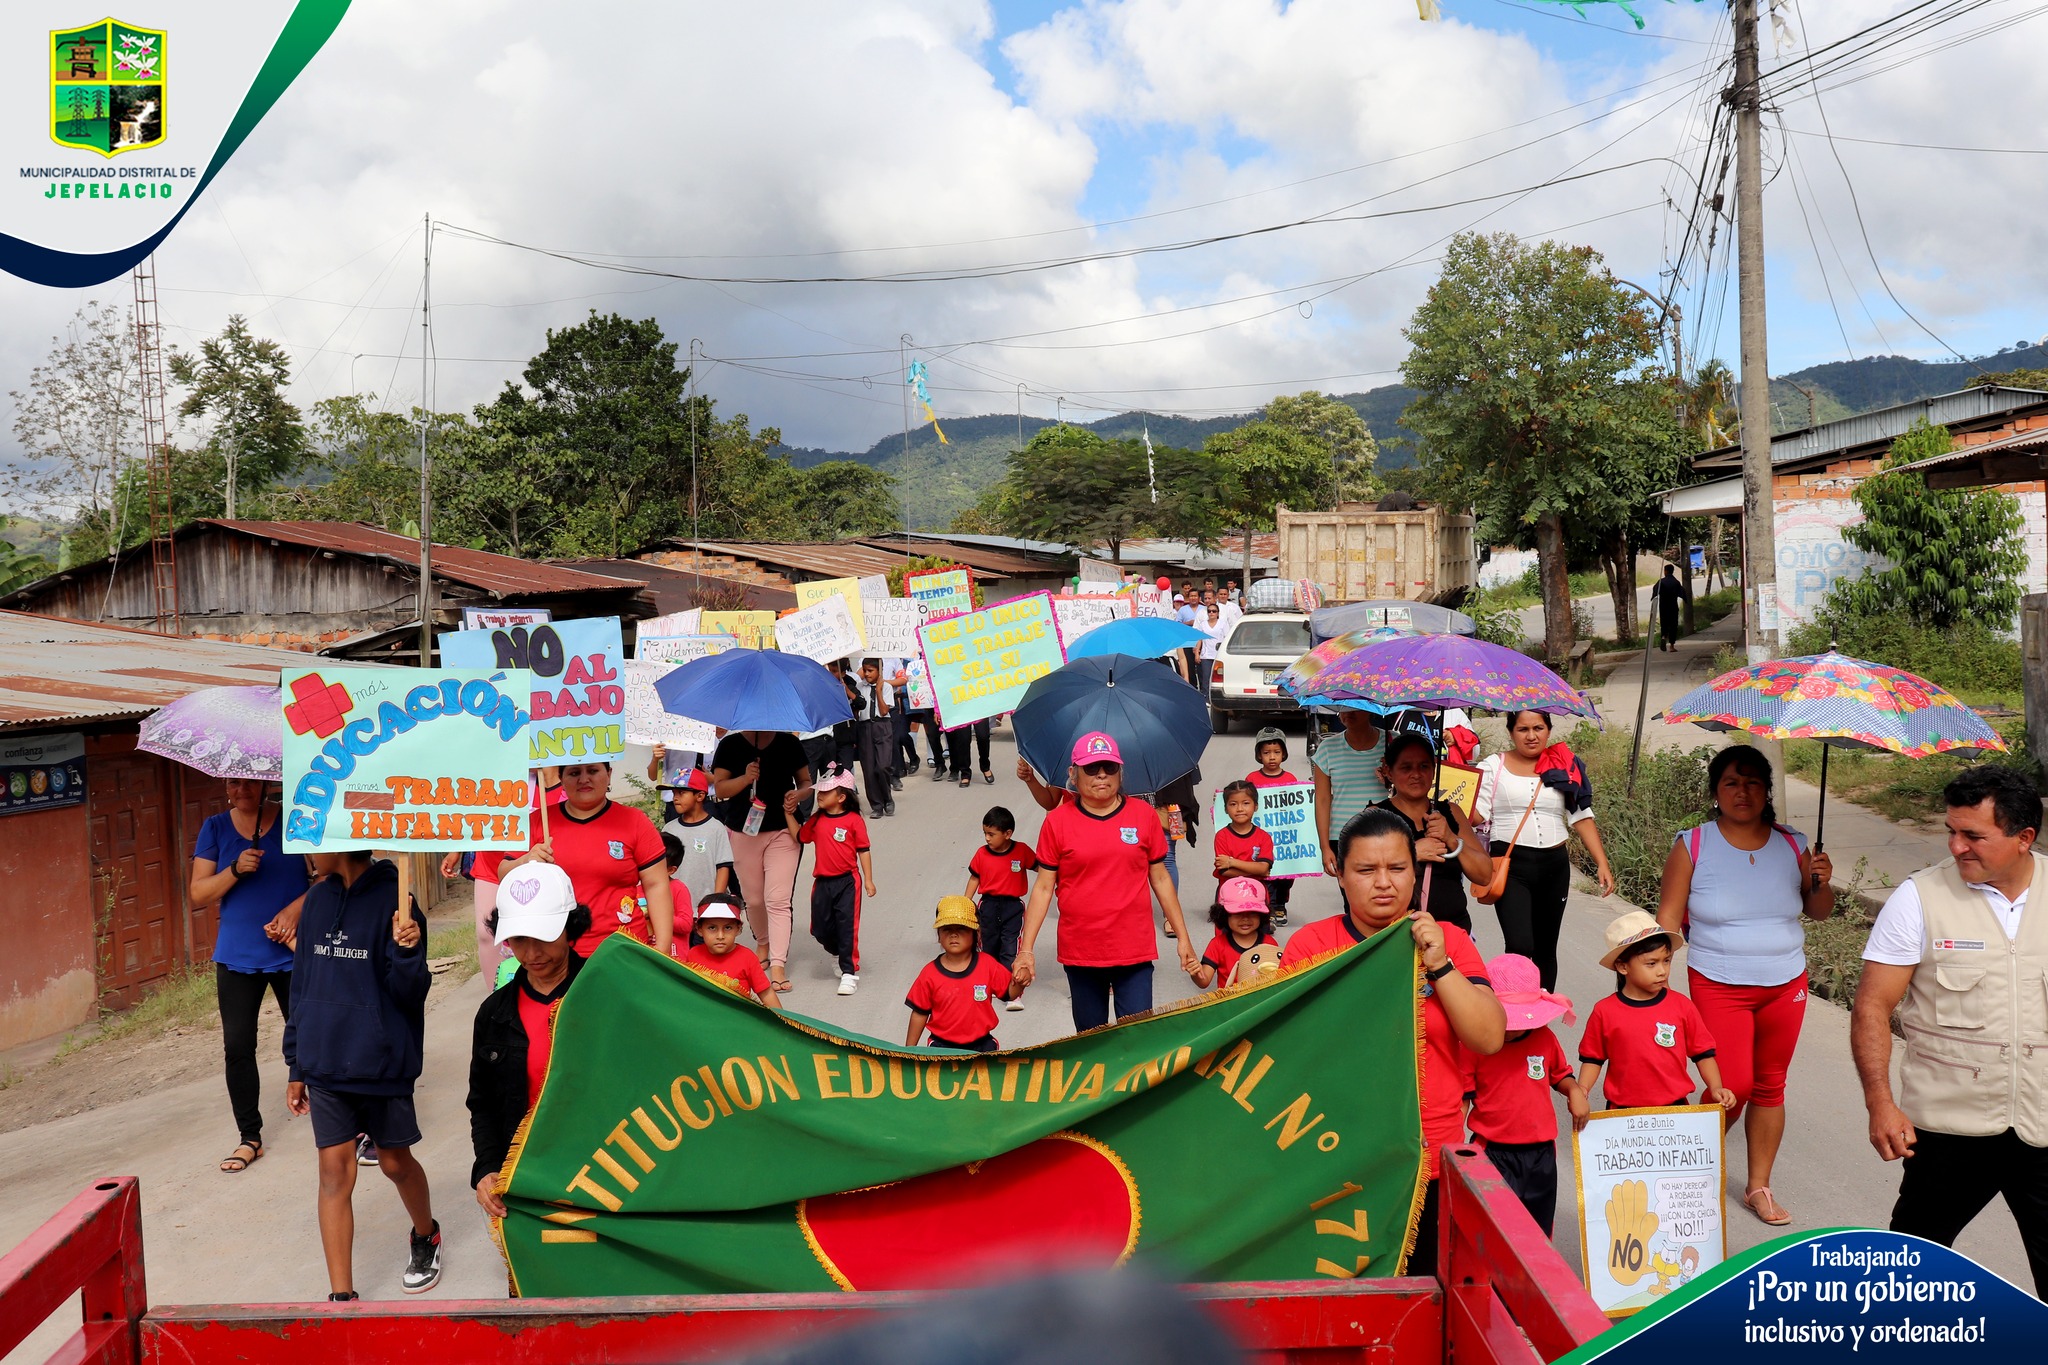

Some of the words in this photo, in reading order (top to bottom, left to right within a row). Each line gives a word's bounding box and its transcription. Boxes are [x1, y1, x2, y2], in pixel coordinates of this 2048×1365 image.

[911, 586, 954, 601] TIEMPO
[954, 584, 969, 594] DE
[873, 599, 915, 614] TRABAJO
[737, 614, 755, 625] NO
[928, 620, 961, 643] QUE
[964, 613, 985, 634] LO
[491, 624, 565, 678] NO
[934, 643, 967, 666] QUE
[972, 621, 1046, 656] TRABAJE
[563, 653, 617, 685] AL
[961, 658, 994, 681] SEA
[1000, 649, 1021, 670] SU
[352, 679, 389, 702] más
[5, 746, 43, 758] confianza
[286, 671, 530, 847] EDUCACIÓN
[346, 783, 380, 791] menos
[385, 775, 529, 808] TRABAJO
[1263, 790, 1305, 809] NIÑOS
[350, 811, 525, 841] INFANTIL
[333, 946, 368, 959] HILFIGER
[811, 1053, 1106, 1103] EDUCATIVA
[1626, 1118, 1636, 1130] 12
[1638, 1117, 1649, 1129] de
[1651, 1117, 1675, 1129] Junio
[1605, 1136, 1620, 1150] DÍA
[1658, 1133, 1694, 1147] CONTRA
[1694, 1133, 1704, 1145] EL
[1594, 1151, 1654, 1171] TRABAJO
[1661, 1183, 1670, 1191] NO
[1671, 1182, 1683, 1190] HAY
[1684, 1181, 1708, 1190] DERECHO
[1669, 1192, 1674, 1200] A
[1675, 1191, 1703, 1200] ROBARLES
[1668, 1201, 1676, 1209] LA
[1683, 1210, 1696, 1219] LOS
[1674, 1219, 1705, 1238] NO!!!
[1611, 1233, 1644, 1272] NO
